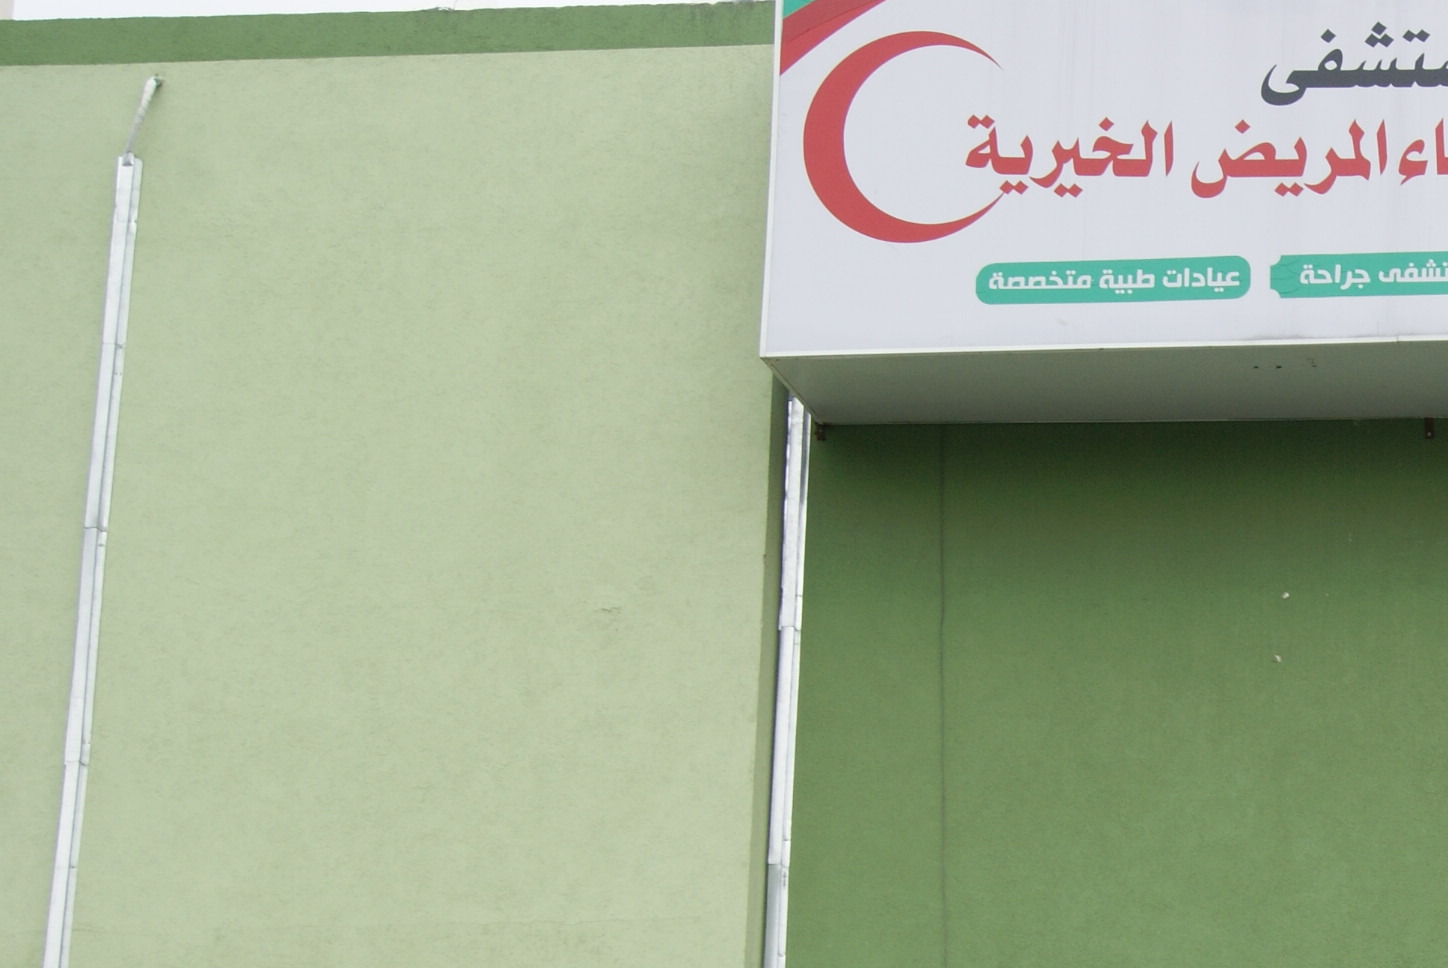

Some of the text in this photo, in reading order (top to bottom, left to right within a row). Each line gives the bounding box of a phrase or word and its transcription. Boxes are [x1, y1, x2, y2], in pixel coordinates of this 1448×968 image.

[965, 116, 1174, 197] الخيرية
[1190, 121, 1388, 199] المريض
[988, 267, 1240, 294] عيادات طبية متخصصة
[1300, 264, 1371, 290] جراحة
